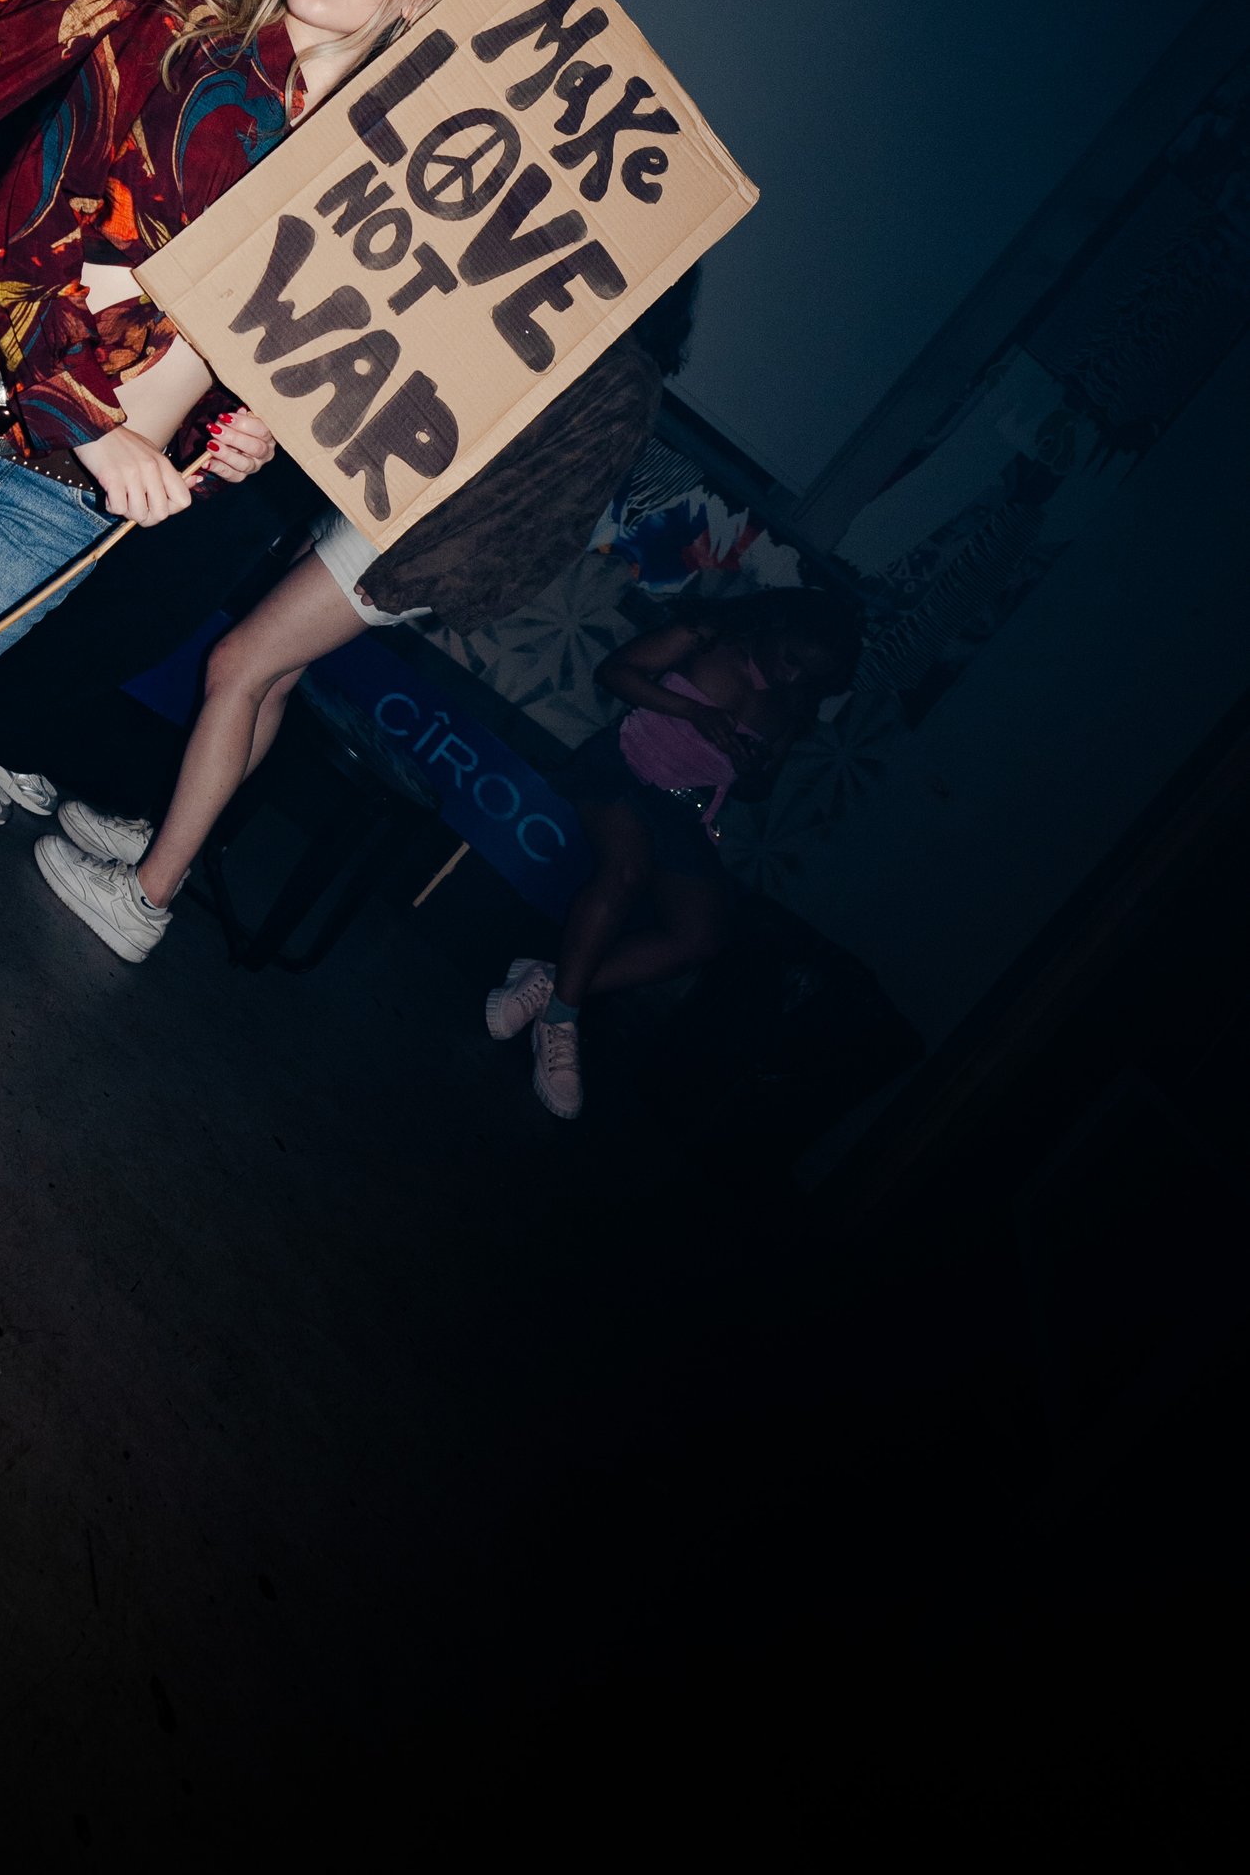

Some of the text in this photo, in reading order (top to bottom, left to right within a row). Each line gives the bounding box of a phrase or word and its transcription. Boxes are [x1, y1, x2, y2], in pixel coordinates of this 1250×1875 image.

[314, 164, 459, 316] NOT
[347, 28, 628, 375] LOVE
[228, 214, 459, 522] WAR
[374, 692, 566, 864] CÎROC
